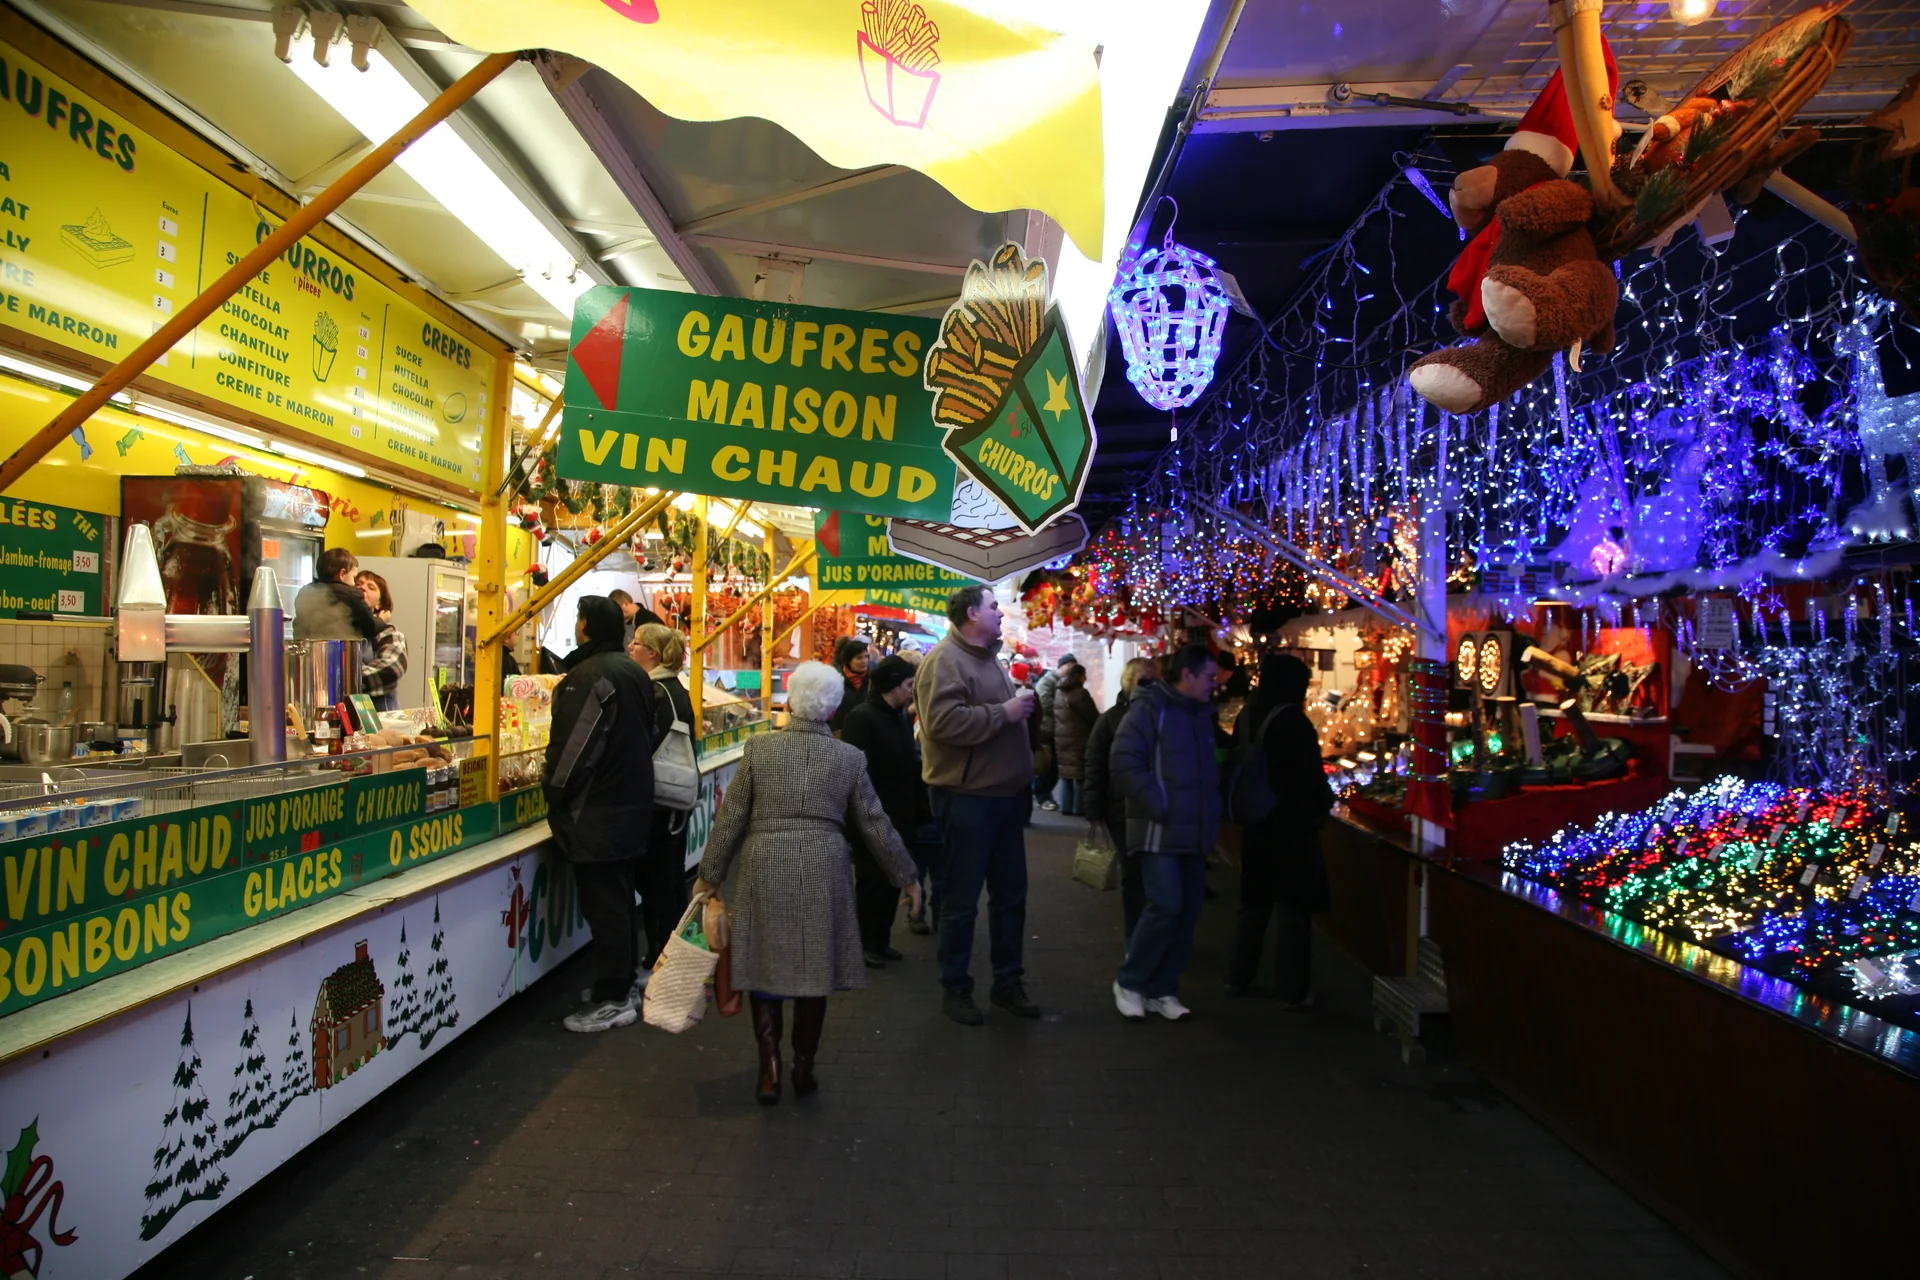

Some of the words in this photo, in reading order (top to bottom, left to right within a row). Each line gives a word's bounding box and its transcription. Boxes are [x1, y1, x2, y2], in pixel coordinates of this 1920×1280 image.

[0, 197, 30, 221] AT
[162, 200, 179, 215] Euros
[162, 220, 167, 230] 2
[160, 246, 165, 257] 3
[256, 221, 355, 302] CURROS
[158, 272, 164, 282] 3
[298, 276, 322, 298] pièces
[157, 297, 162, 307] 3
[29, 303, 118, 350] MARRON
[222, 300, 290, 341] CHOCOLAT
[220, 323, 290, 364] CHANTILLY
[396, 345, 423, 368] SUCRE
[422, 322, 471, 370] CREPES
[677, 311, 921, 378] GAUFRES
[218, 348, 291, 388] CONFITURE
[394, 364, 429, 390] NUTELLA
[216, 372, 262, 400] CREME
[266, 391, 282, 407] DE
[286, 399, 334, 427] MARRON
[392, 382, 434, 409] CHOCOLAT
[686, 379, 897, 442] MAISON
[387, 438, 416, 458] CREME
[418, 449, 429, 462] DE
[430, 455, 462, 474] MARRON
[578, 429, 687, 475] VIN
[711, 445, 937, 503] CHAUD
[978, 438, 1060, 501] CHURROS
[72, 512, 98, 541] THE
[0, 545, 72, 576] Jambon-fromage
[75, 556, 91, 570] 3,50
[823, 565, 852, 583] JUS
[857, 563, 935, 583] D'ORANGE
[0, 589, 56, 612] bon-oeuf
[60, 595, 76, 609] 3,50
[870, 588, 903, 605] VIN
[246, 801, 275, 843] JUS
[280, 787, 344, 834] D'ORANGE
[356, 781, 420, 826] CHURROS
[409, 812, 463, 860] SSONS
[4, 839, 88, 921] VIN
[103, 815, 232, 896] CHAUD
[269, 849, 280, 861] 25
[244, 847, 342, 917] GLACES
